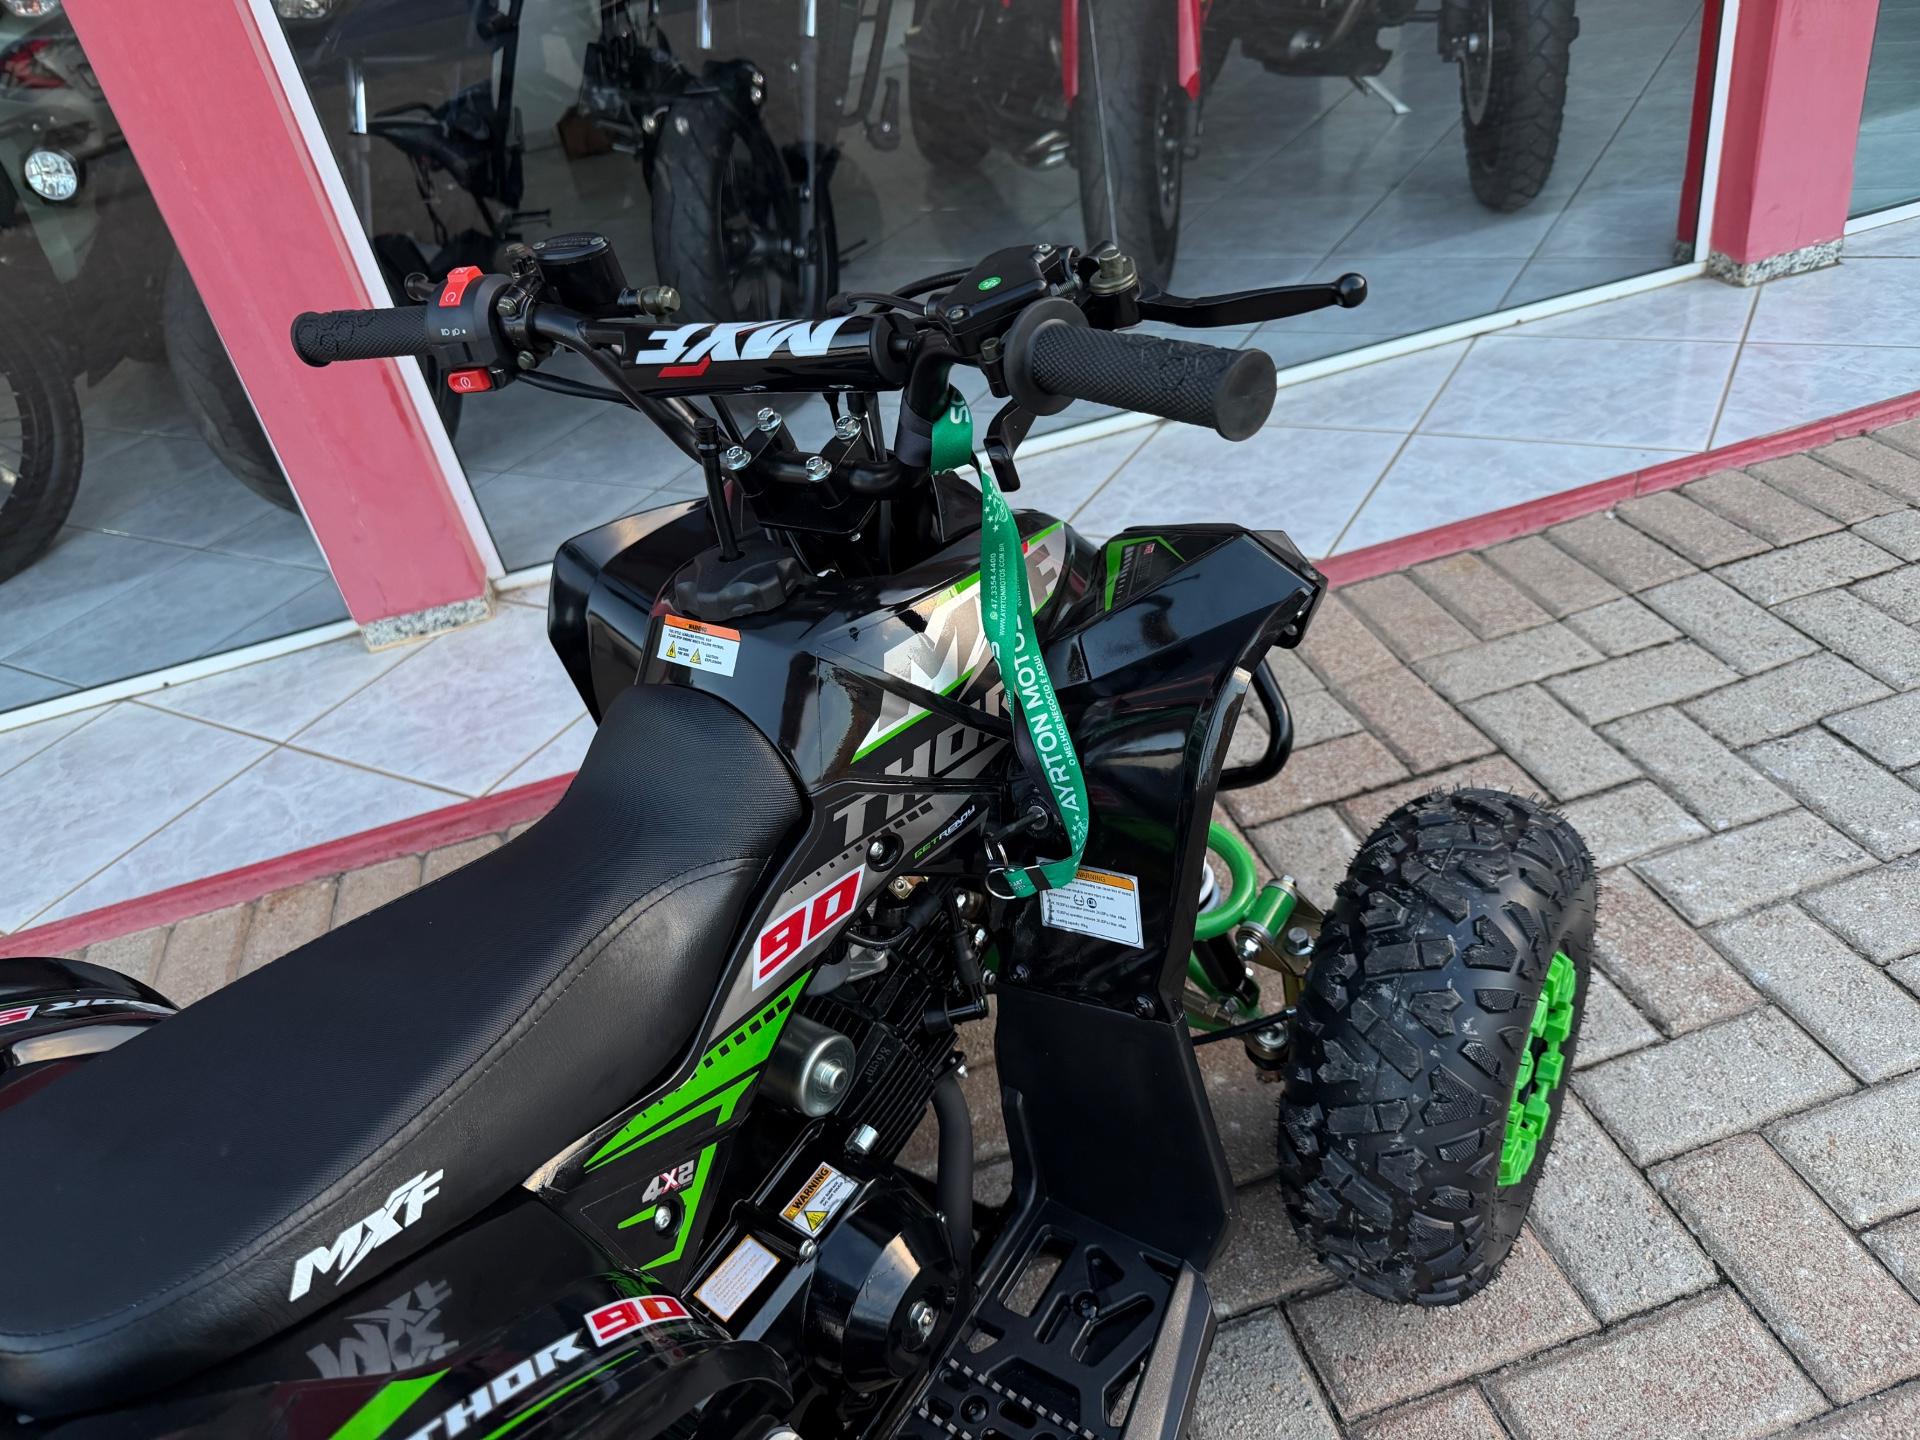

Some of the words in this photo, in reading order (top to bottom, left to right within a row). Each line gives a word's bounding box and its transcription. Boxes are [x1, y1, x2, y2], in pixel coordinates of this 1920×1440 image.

[1033, 655, 1047, 677] AQUI
[1039, 677, 1047, 685] É
[1055, 723, 1073, 758] MELHOR
[1030, 712, 1081, 812] AYRTON
[1068, 758, 1076, 766] O
[755, 866, 863, 986] 90
[792, 1167, 829, 1209] WARNING
[289, 1168, 444, 1302] MXF
[586, 1296, 691, 1345] 90
